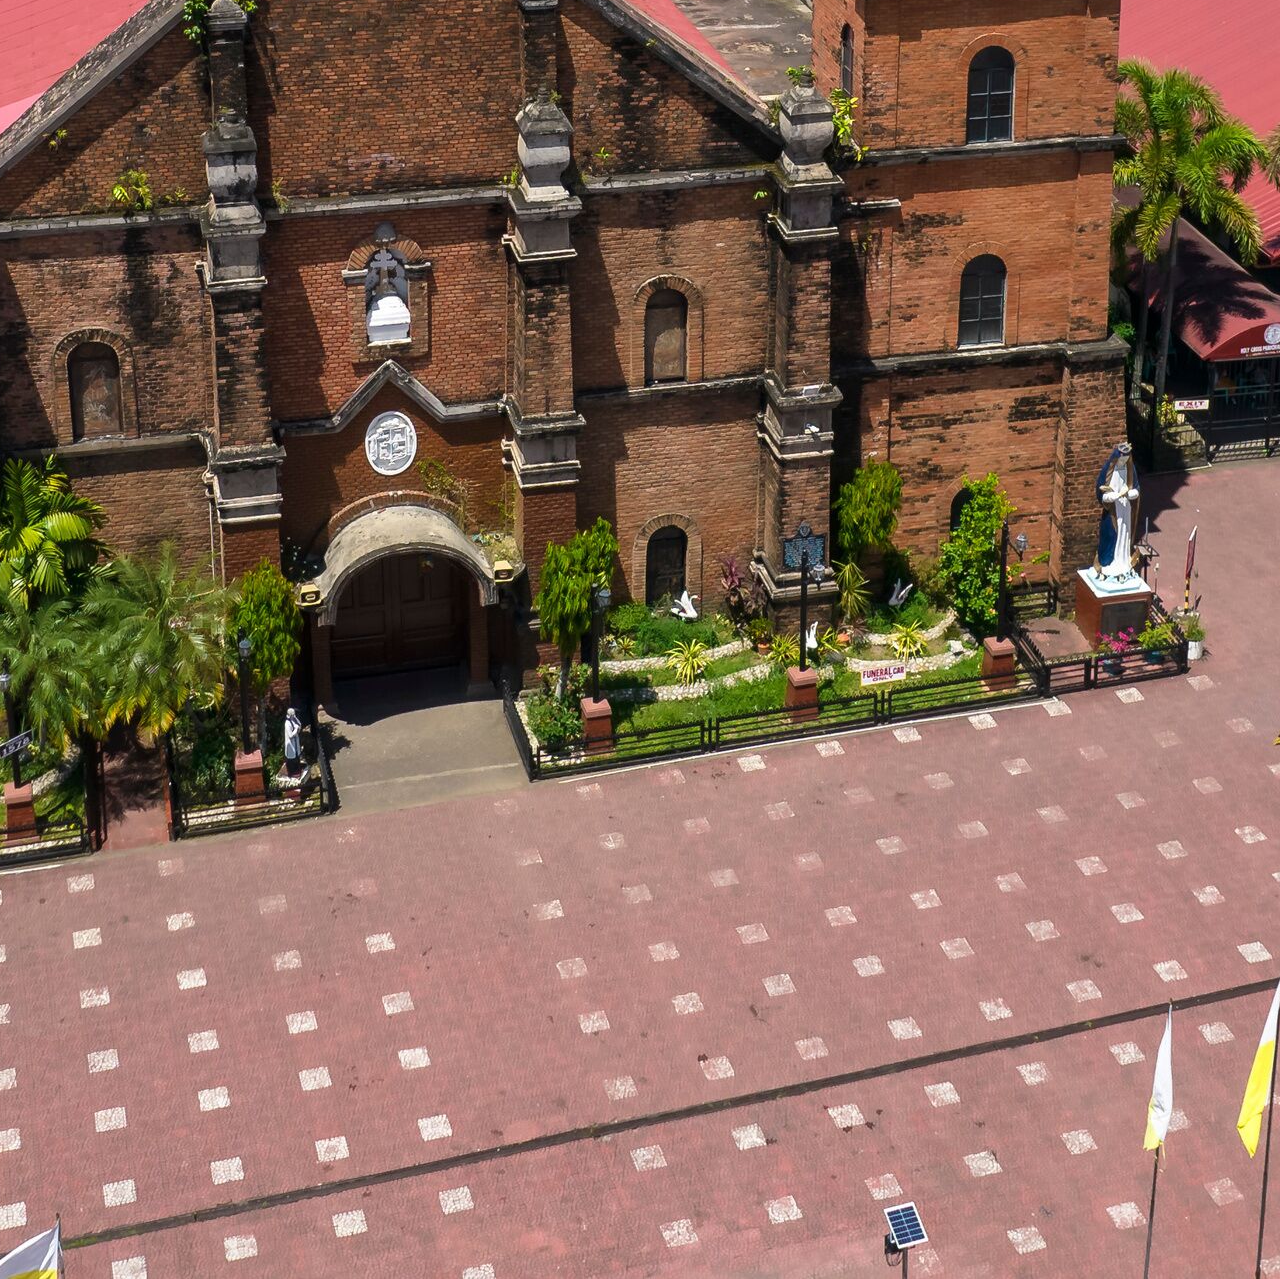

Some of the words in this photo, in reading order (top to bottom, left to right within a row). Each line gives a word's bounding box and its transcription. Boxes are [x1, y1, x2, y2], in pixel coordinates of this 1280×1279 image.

[862, 666, 893, 679] FUNERAL
[892, 666, 905, 674] CAR
[872, 674, 894, 682] ONLY
